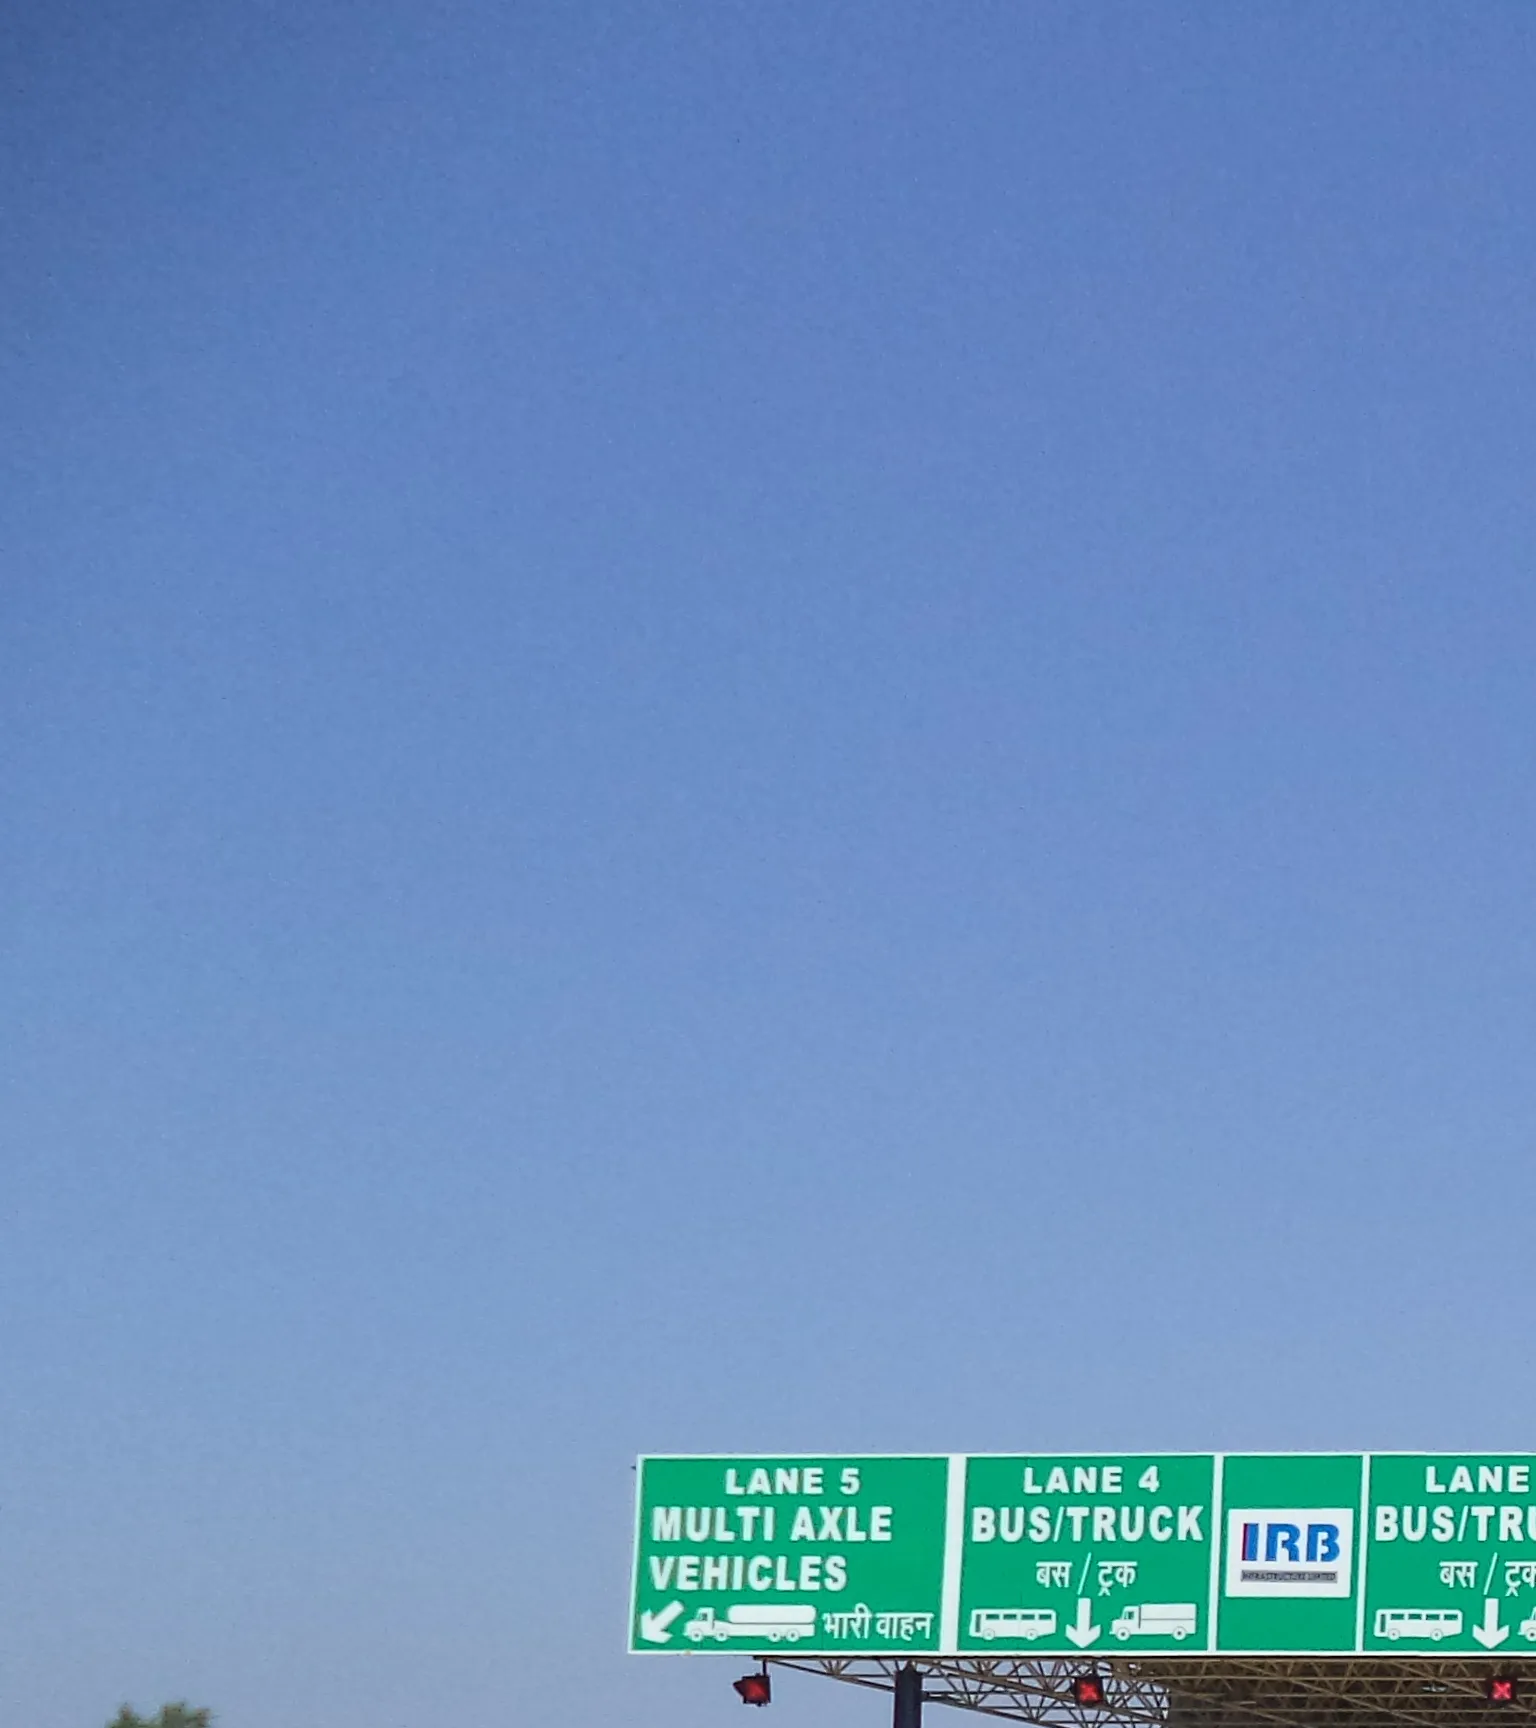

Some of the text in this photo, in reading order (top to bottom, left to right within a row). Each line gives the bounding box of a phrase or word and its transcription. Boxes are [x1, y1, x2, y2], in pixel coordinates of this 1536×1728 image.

[726, 1467, 860, 1495] LANE 5
[1024, 1466, 1159, 1494] LANE 4
[1426, 1465, 1529, 1493] LANE
[653, 1506, 892, 1542] MULTI AXLE
[972, 1505, 1203, 1542] BUS/TRUCK
[1241, 1522, 1340, 1562] IRB
[650, 1555, 847, 1591] VEHICLES
[1036, 1561, 1072, 1588] बस
[1098, 1561, 1137, 1596] ट्रक
[1439, 1561, 1478, 1588] बस
[823, 1604, 934, 1641] भारी वाहन
